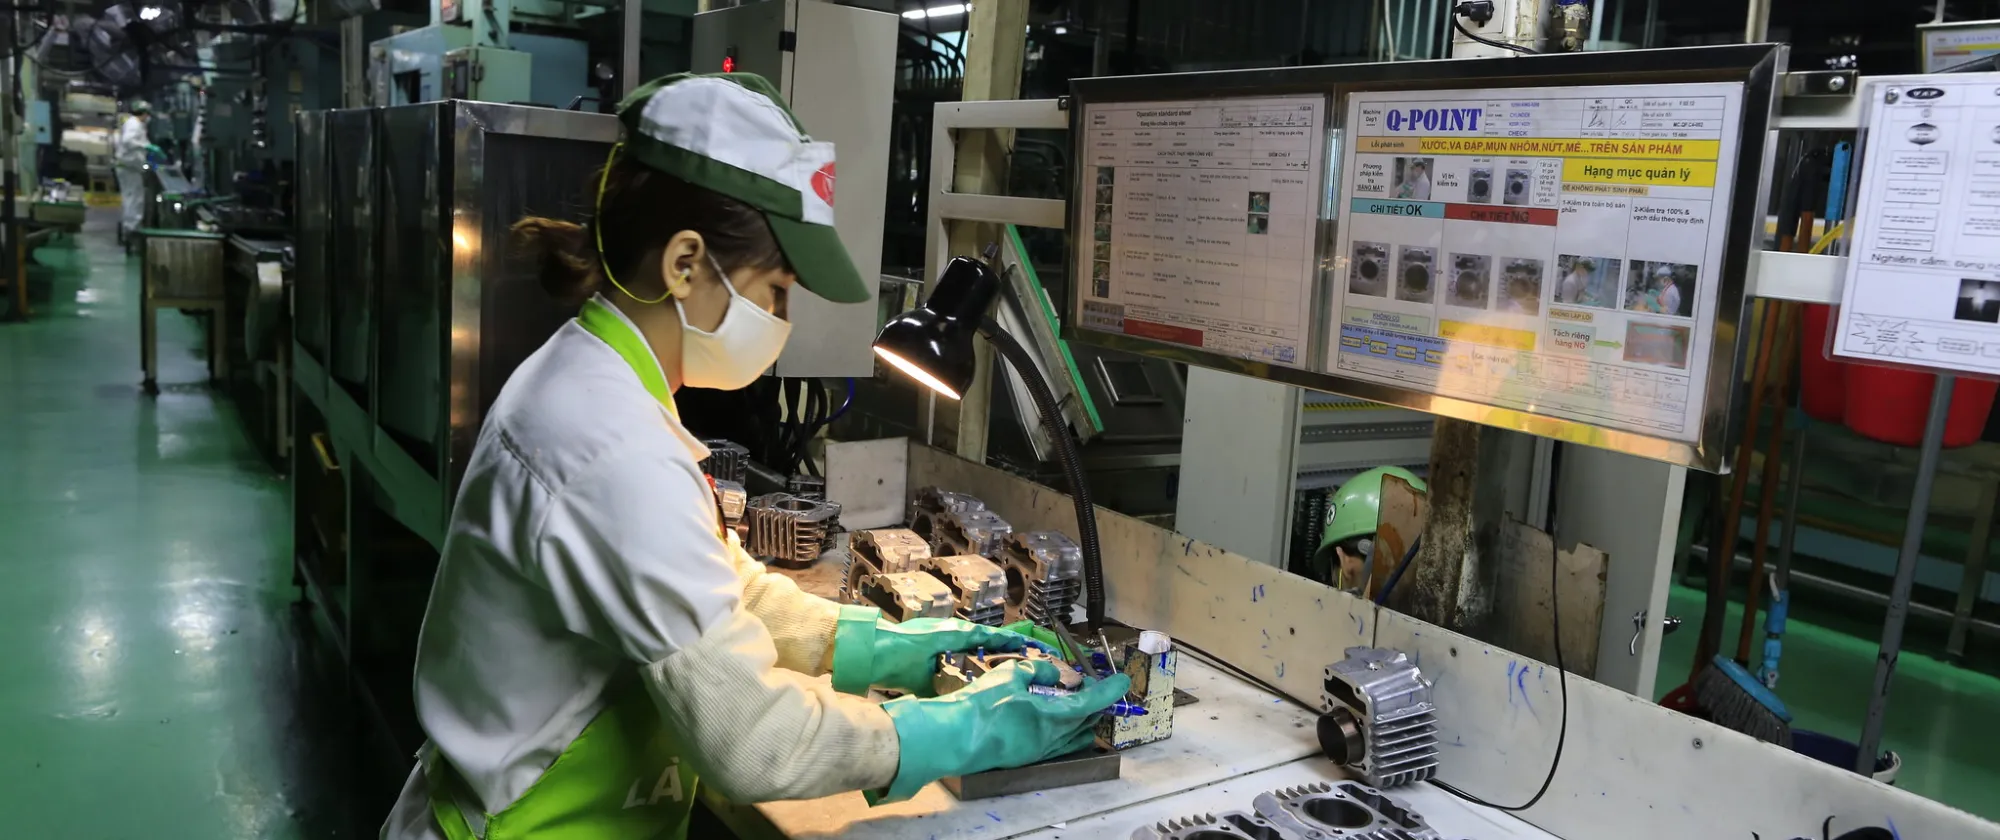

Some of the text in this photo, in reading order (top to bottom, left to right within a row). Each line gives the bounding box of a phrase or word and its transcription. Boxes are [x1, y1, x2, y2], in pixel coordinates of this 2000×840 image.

[1386, 108, 1482, 131] Q-POINT
[1371, 140, 1380, 148] Lỗi
[1584, 165, 1690, 182] Hạng mục quản lý
[1370, 204, 1384, 214] CHI
[1406, 204, 1422, 216] OK
[1871, 254, 1917, 264] Nghiêm
[1553, 328, 1590, 342] Tách riêng
[1554, 338, 1586, 350] hàng NG
